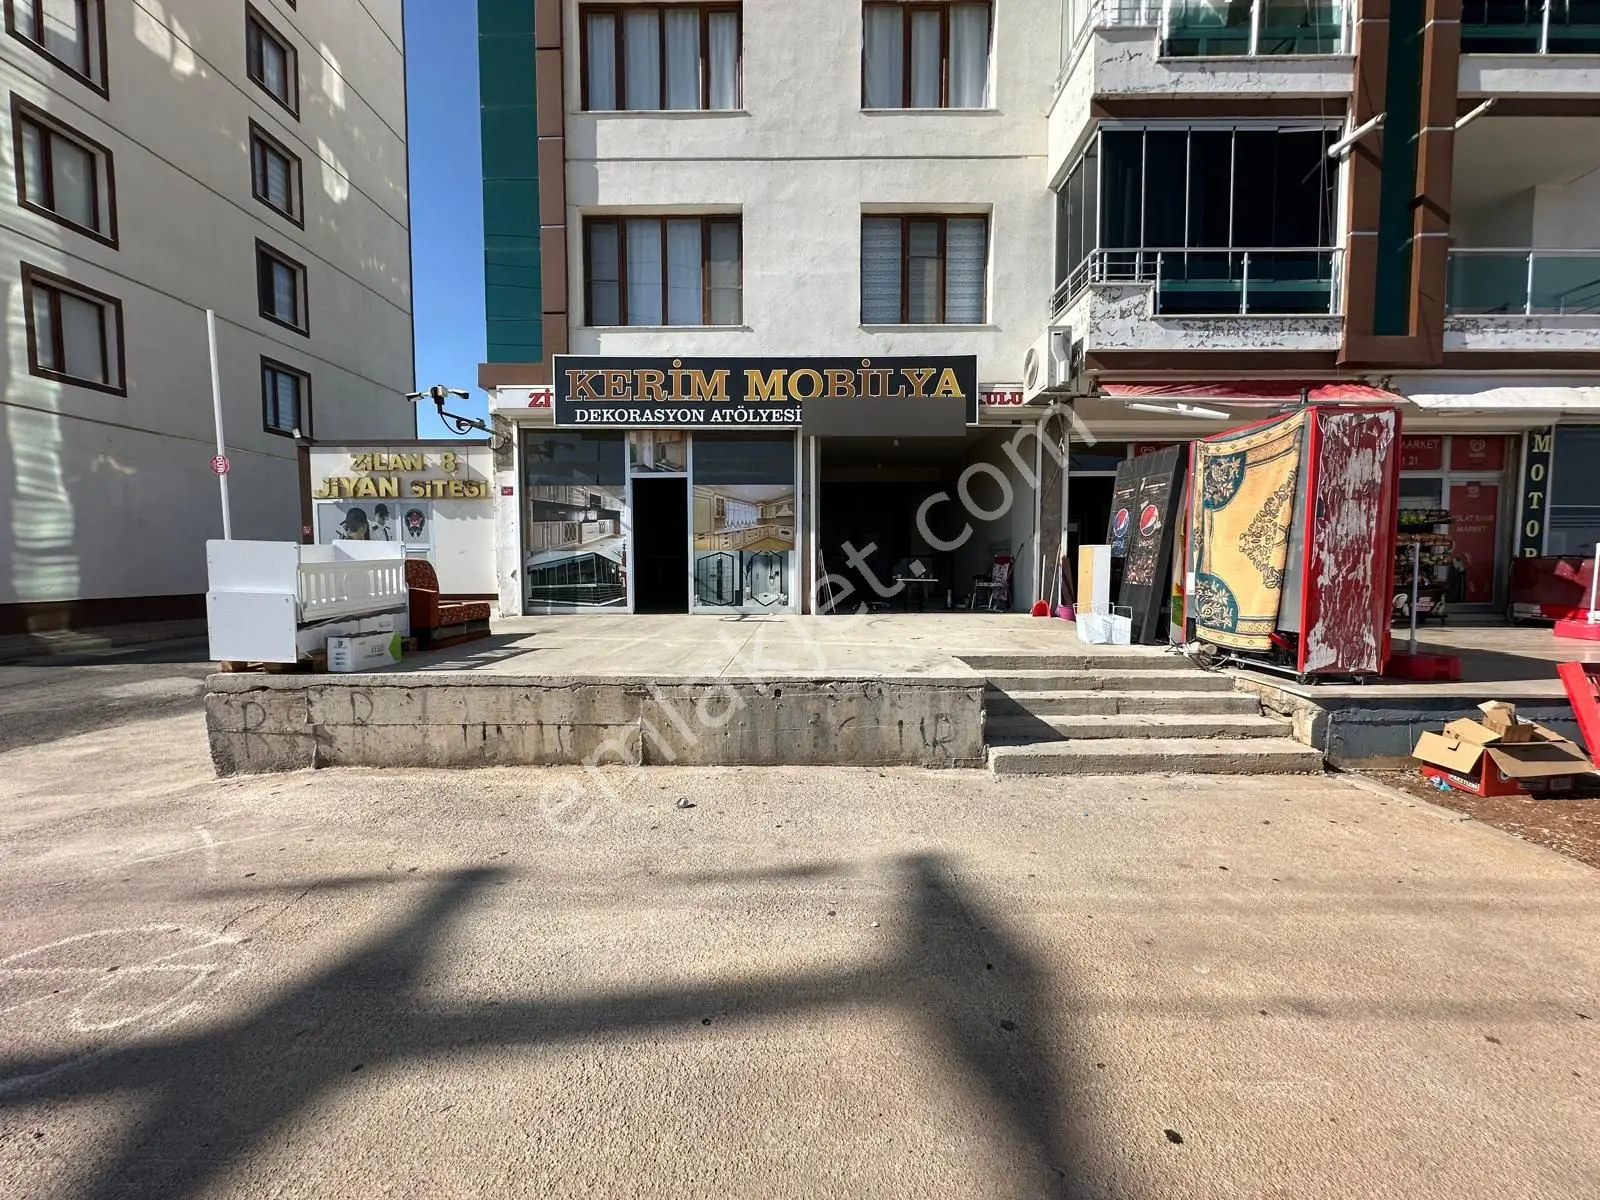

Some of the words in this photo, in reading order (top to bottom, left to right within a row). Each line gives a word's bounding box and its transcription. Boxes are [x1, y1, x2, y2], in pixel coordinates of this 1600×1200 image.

[565, 358, 730, 401] KERİM
[743, 358, 966, 401] MOBİLYA
[528, 387, 554, 408] Zİ
[575, 408, 705, 423] DEKORASYON
[710, 404, 803, 423] ATÖLYESİ
[215, 456, 225, 474] DUR
